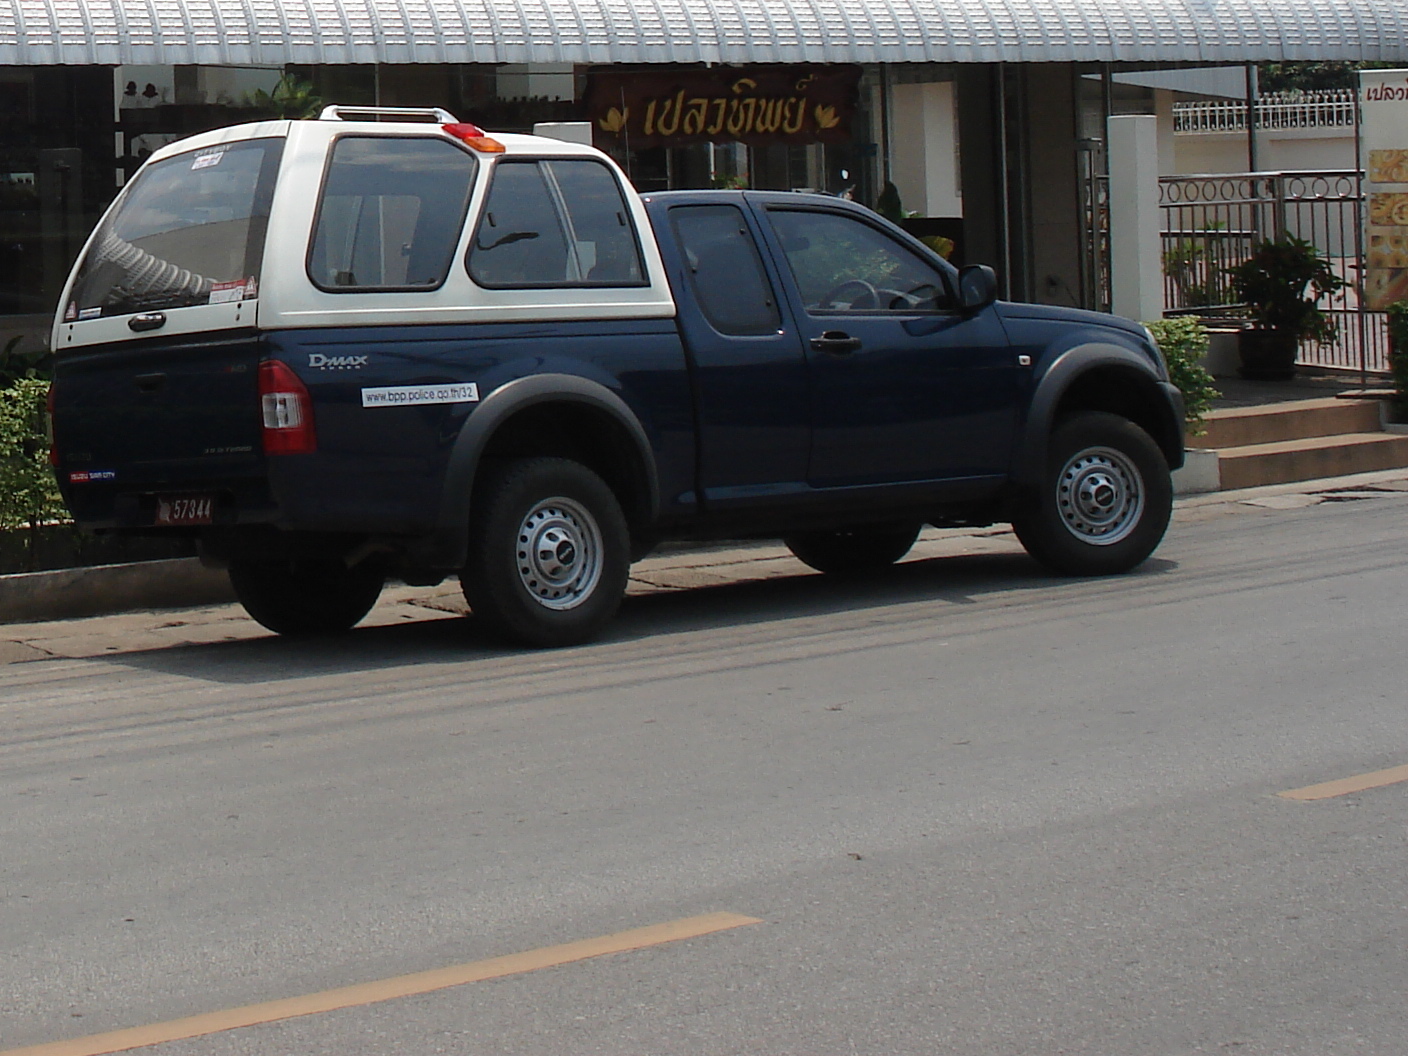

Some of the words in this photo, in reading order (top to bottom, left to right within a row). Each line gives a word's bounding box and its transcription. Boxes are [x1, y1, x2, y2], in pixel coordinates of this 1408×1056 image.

[643, 74, 818, 137] เปลวทิพย์
[365, 385, 475, 404] www.bpp.police.go.th/32
[173, 498, 212, 520] 57344
